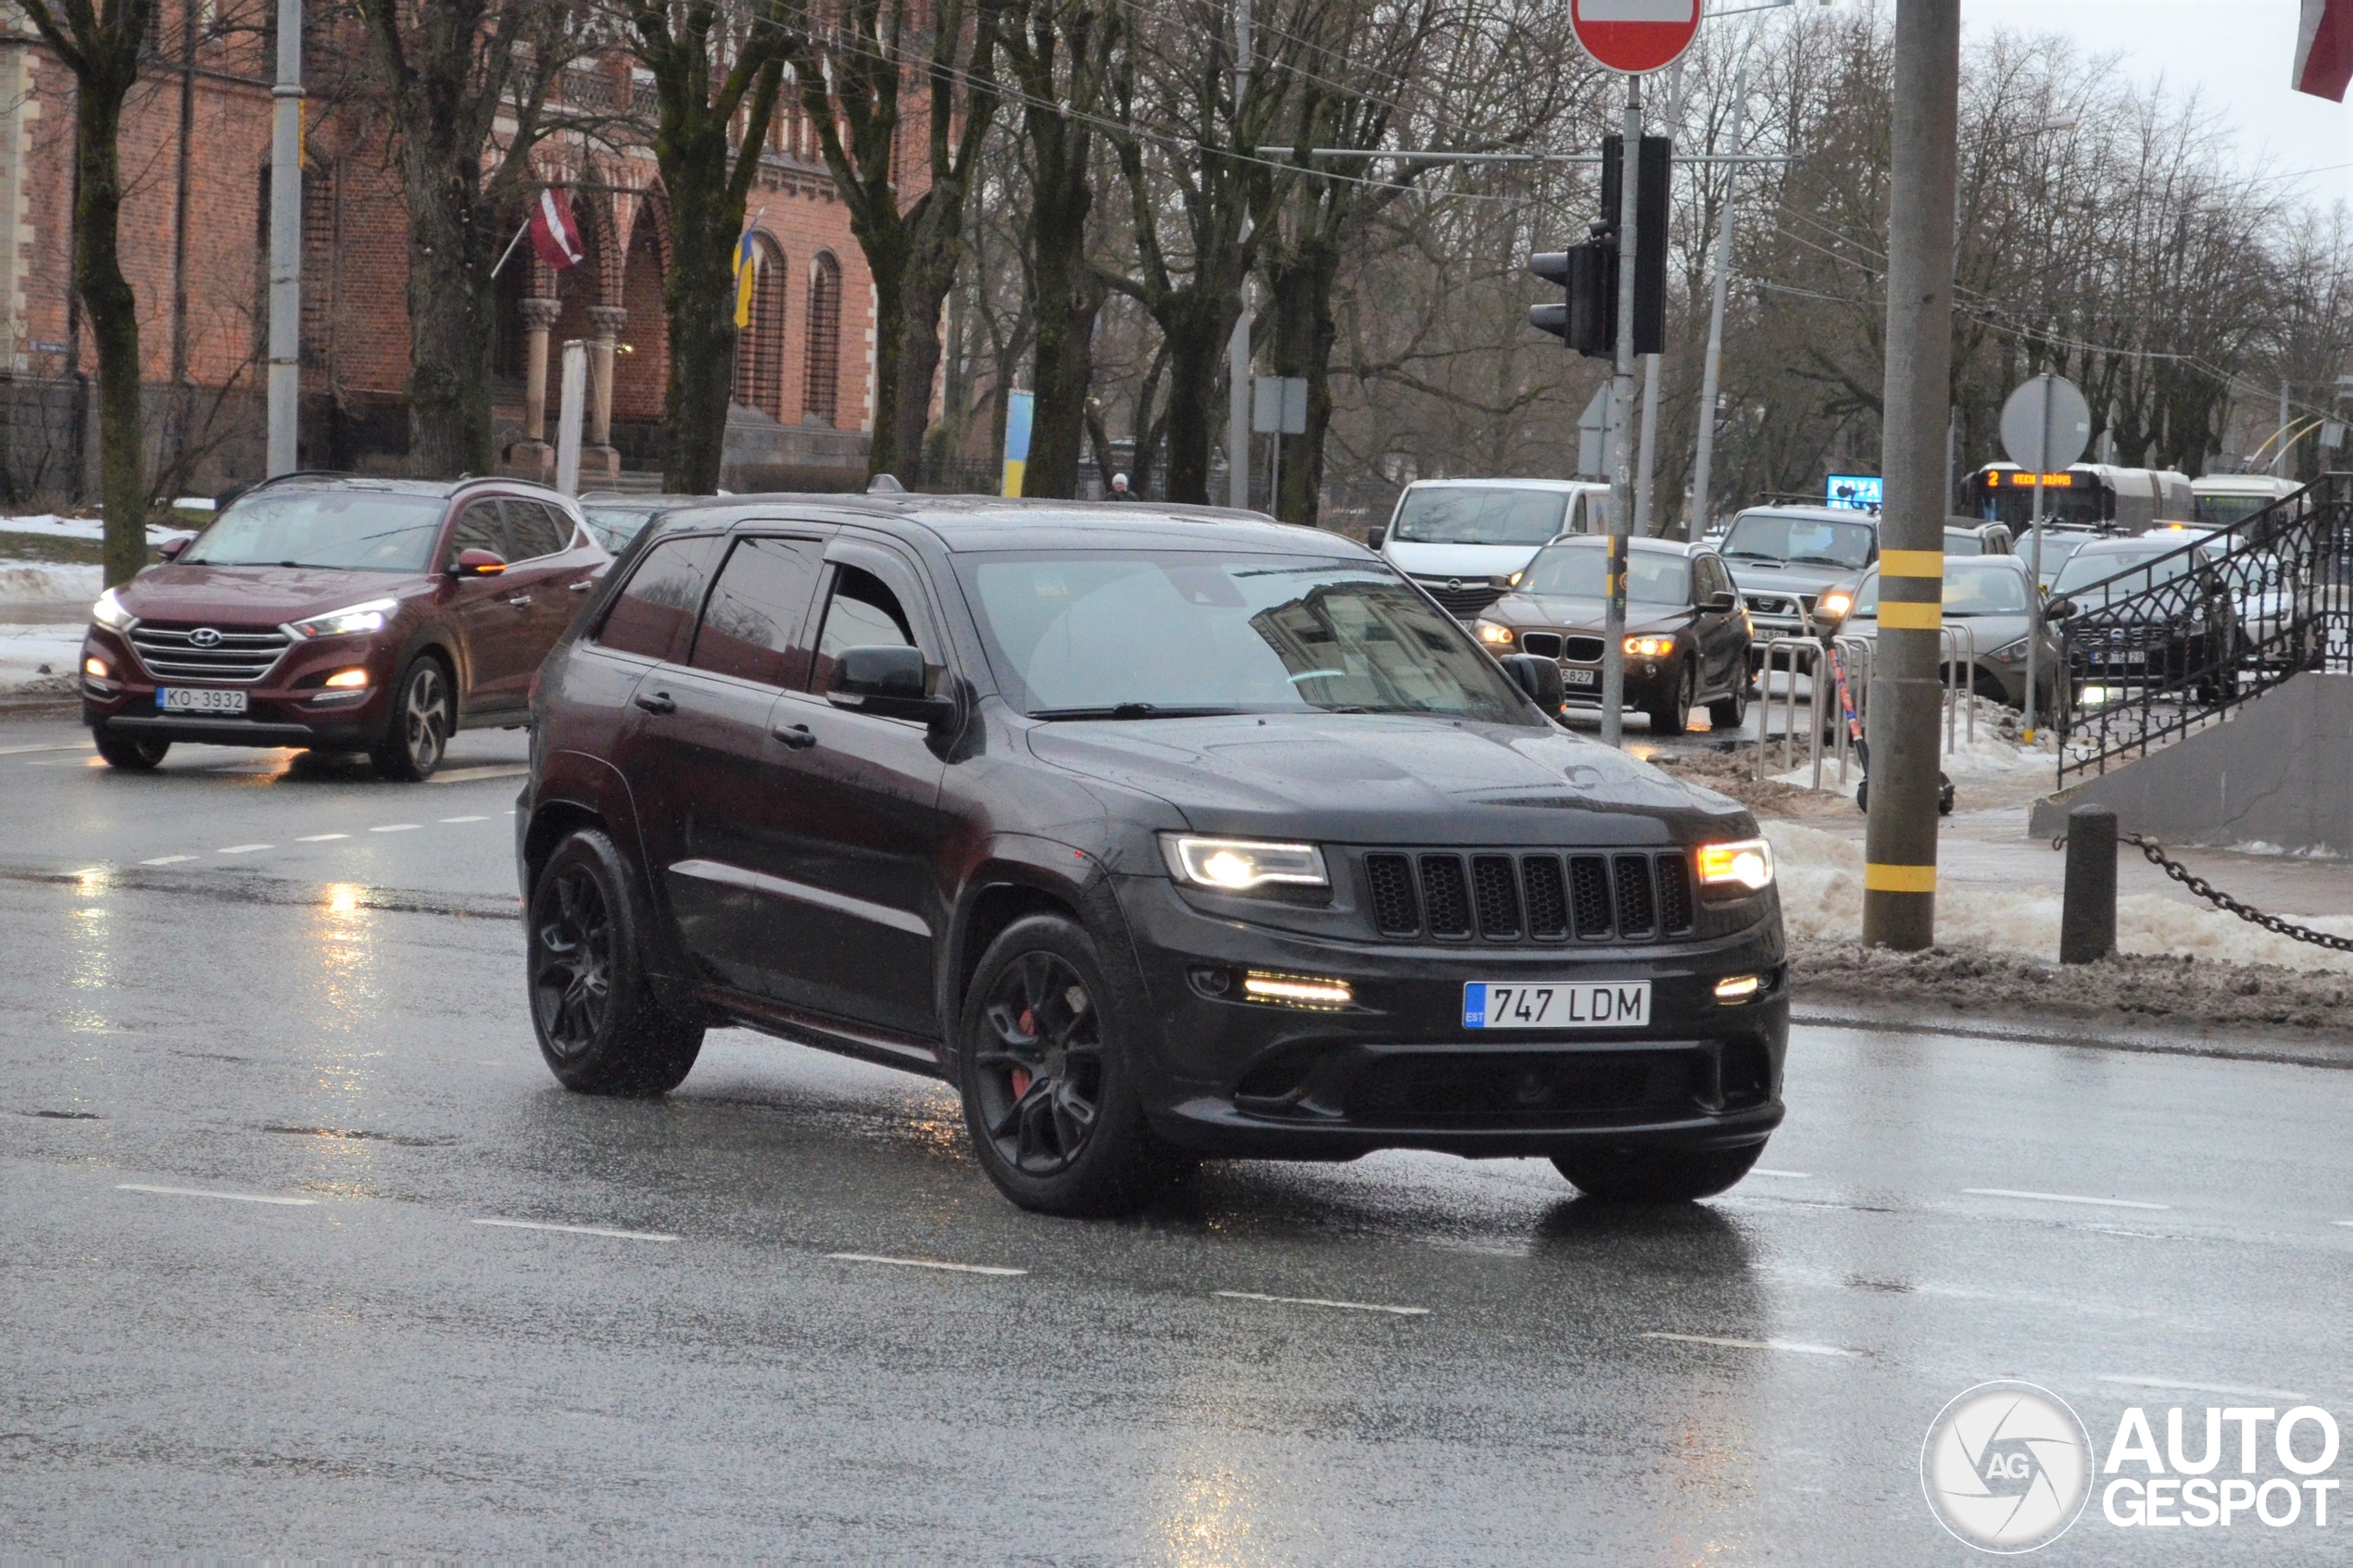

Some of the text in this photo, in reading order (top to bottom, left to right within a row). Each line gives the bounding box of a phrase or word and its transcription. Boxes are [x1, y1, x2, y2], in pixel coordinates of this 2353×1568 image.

[1987, 470, 1999, 487] 2
[168, 690, 243, 709] KO-3932
[1494, 987, 1642, 1022] 747 LDM
[1466, 1012, 1483, 1022] EST
